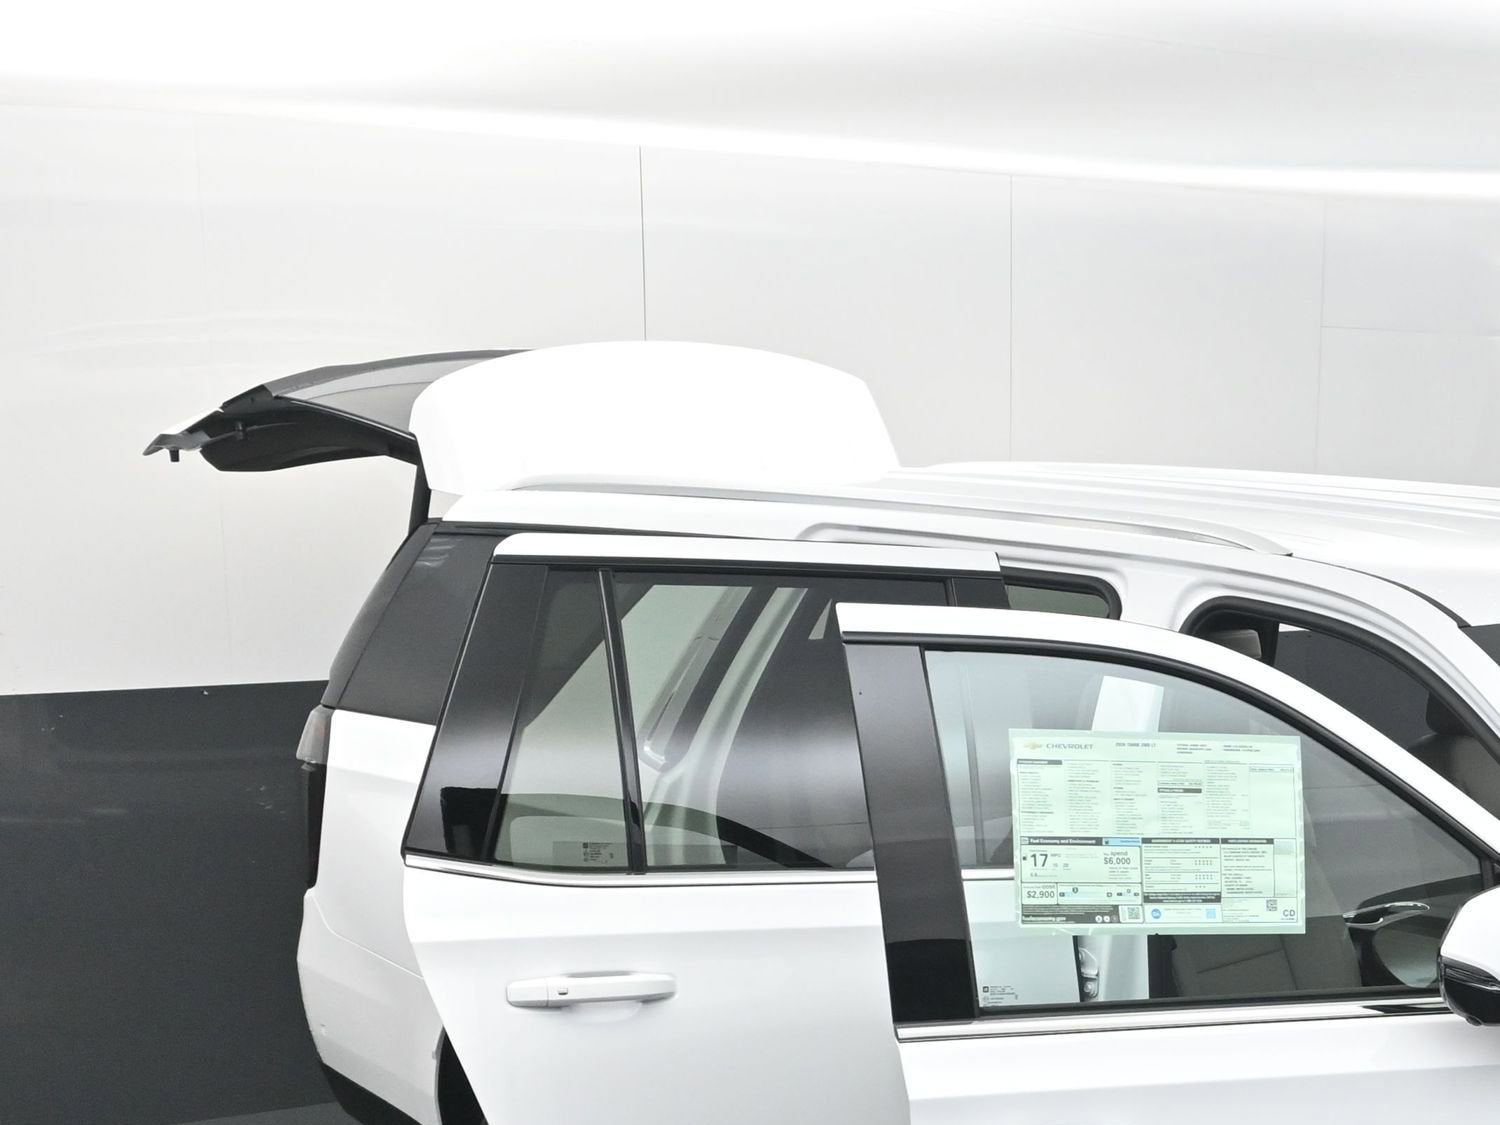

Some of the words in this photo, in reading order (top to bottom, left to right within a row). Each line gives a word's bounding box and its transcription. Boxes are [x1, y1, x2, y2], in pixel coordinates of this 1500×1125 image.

[1030, 853, 1048, 868] 17
[1104, 857, 1131, 866] $6,000
[1027, 890, 1055, 899] $2,900
[1282, 909, 1296, 917] CD
